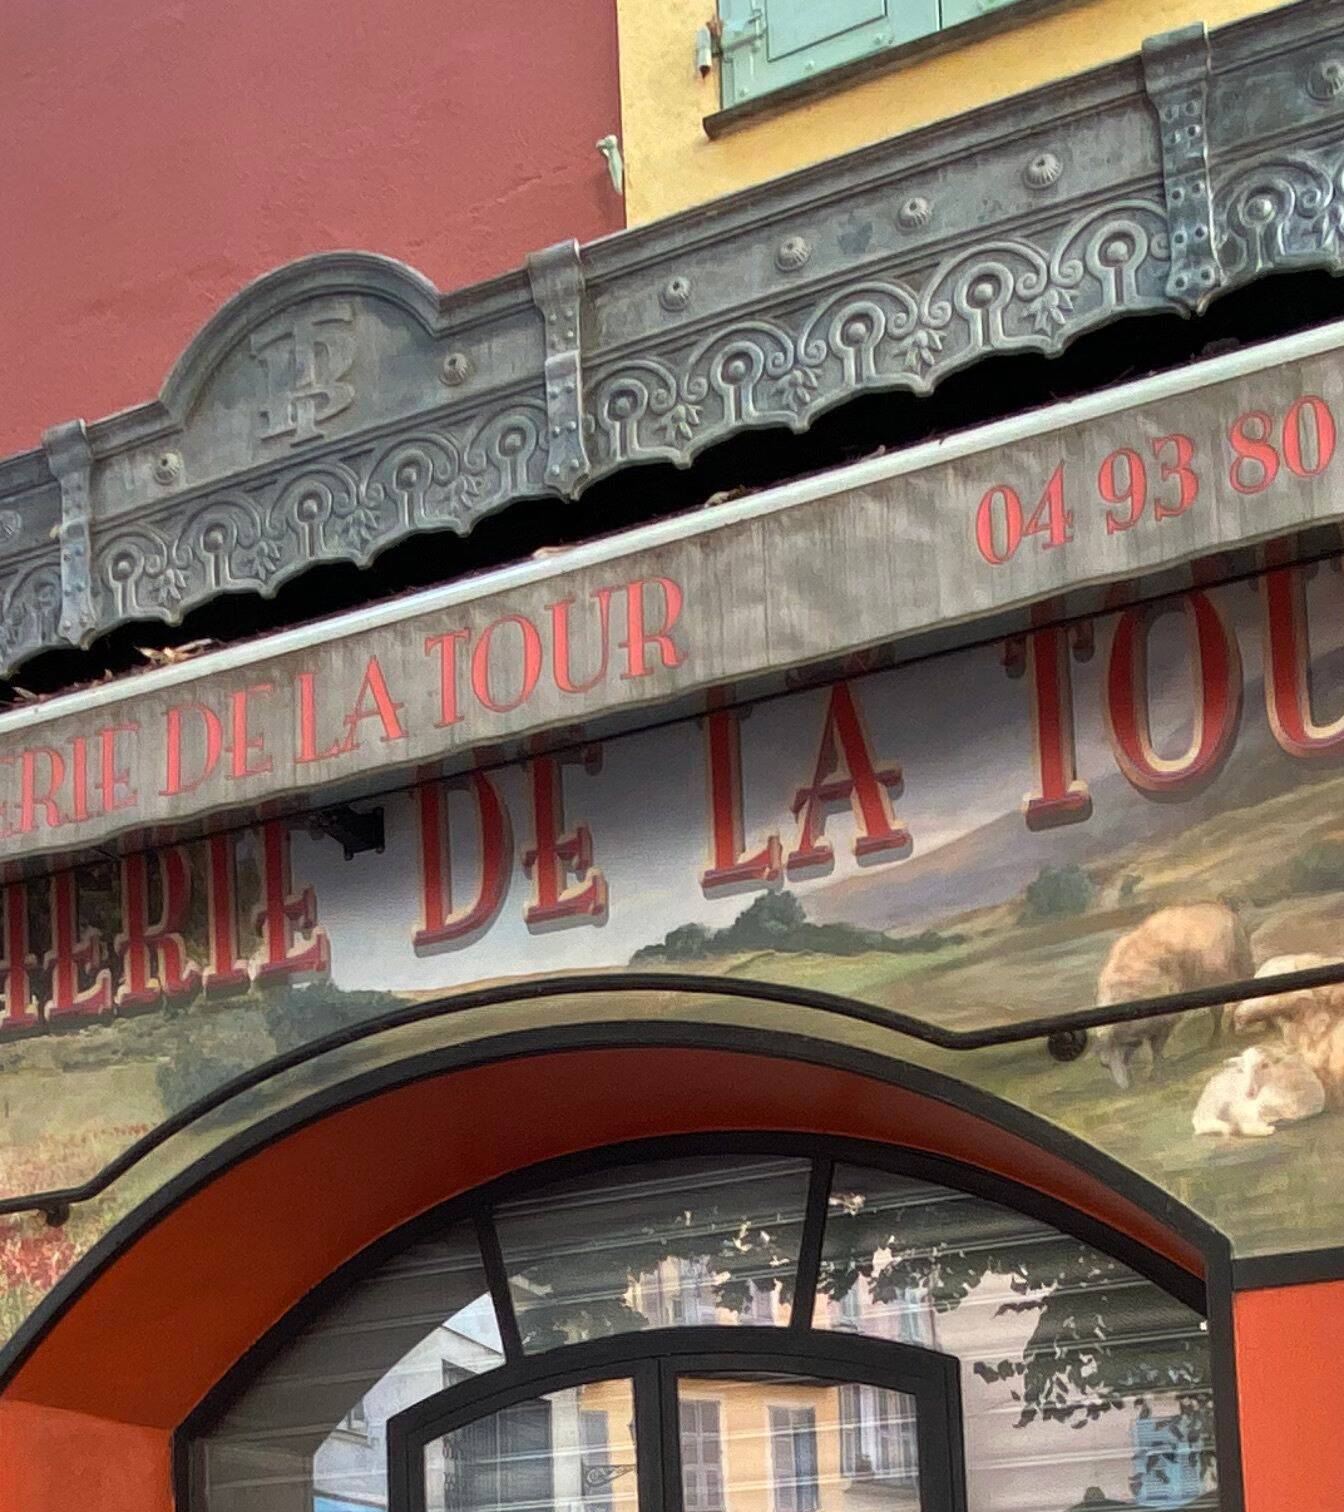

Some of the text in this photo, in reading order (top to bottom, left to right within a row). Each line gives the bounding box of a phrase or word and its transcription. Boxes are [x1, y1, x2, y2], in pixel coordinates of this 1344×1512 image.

[975, 460, 1075, 566] 04
[1097, 434, 1200, 536] 93
[1228, 394, 1337, 494] 80
[157, 683, 274, 798] DE
[293, 654, 409, 765] LA
[423, 576, 689, 729] TOUR
[413, 734, 610, 958] DE
[699, 662, 913, 901] LA
